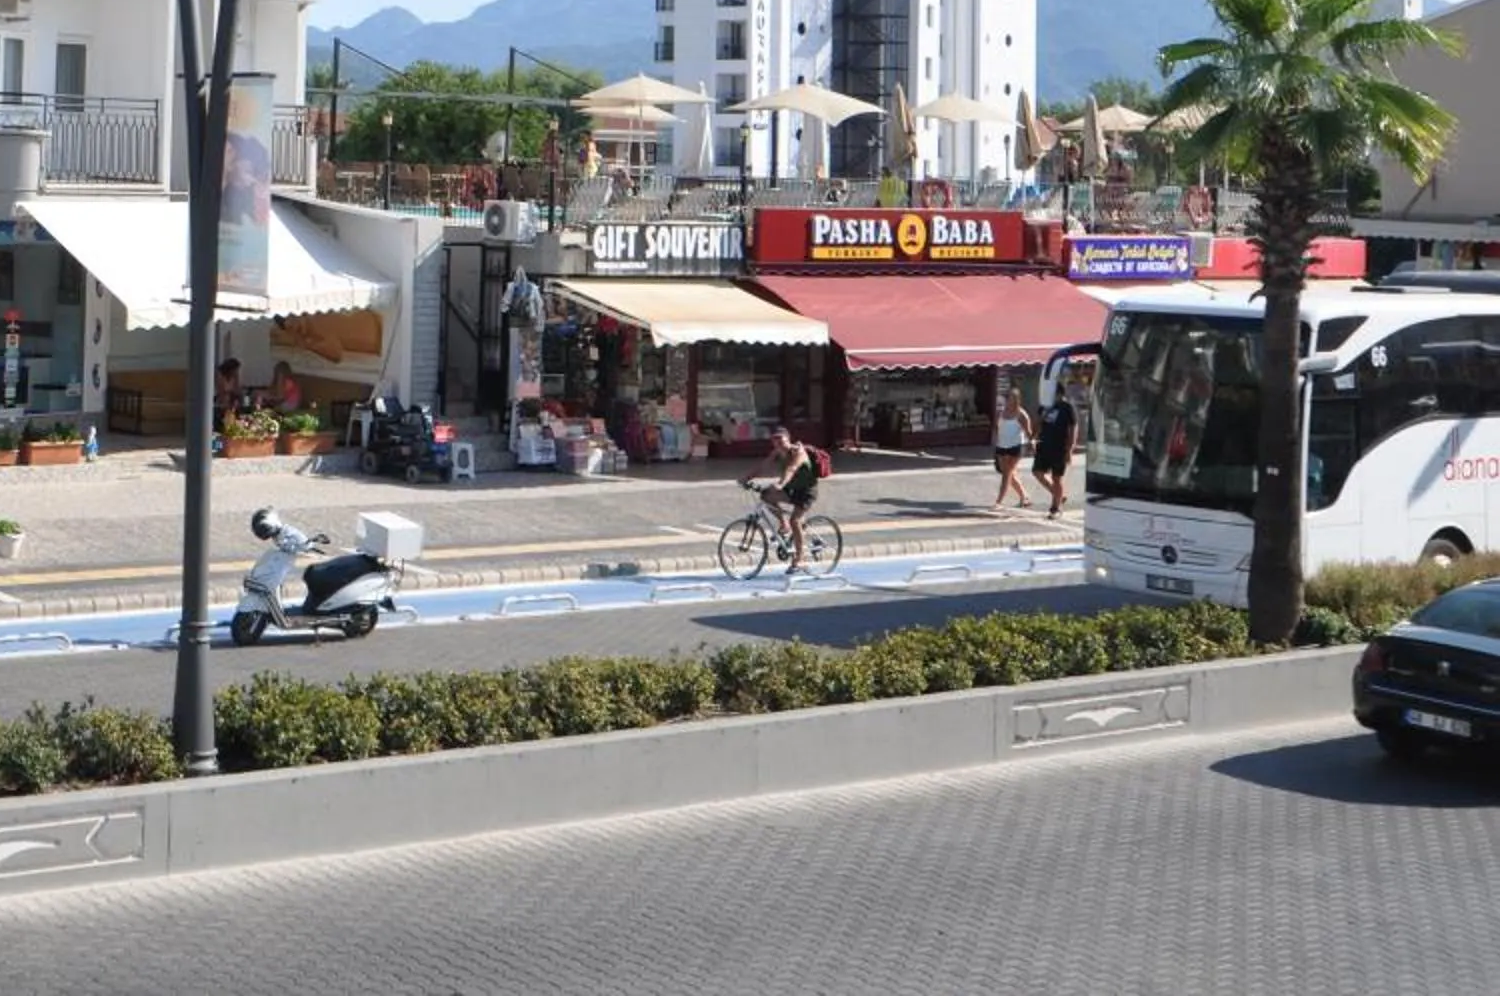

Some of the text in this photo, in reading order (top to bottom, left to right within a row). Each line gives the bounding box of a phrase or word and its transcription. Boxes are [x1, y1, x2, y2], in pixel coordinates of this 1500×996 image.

[813, 213, 994, 244] PASHA BABA
[593, 225, 743, 260] GIFT SOUVENIR
[1111, 315, 1129, 335] 66
[1371, 345, 1388, 367] 66
